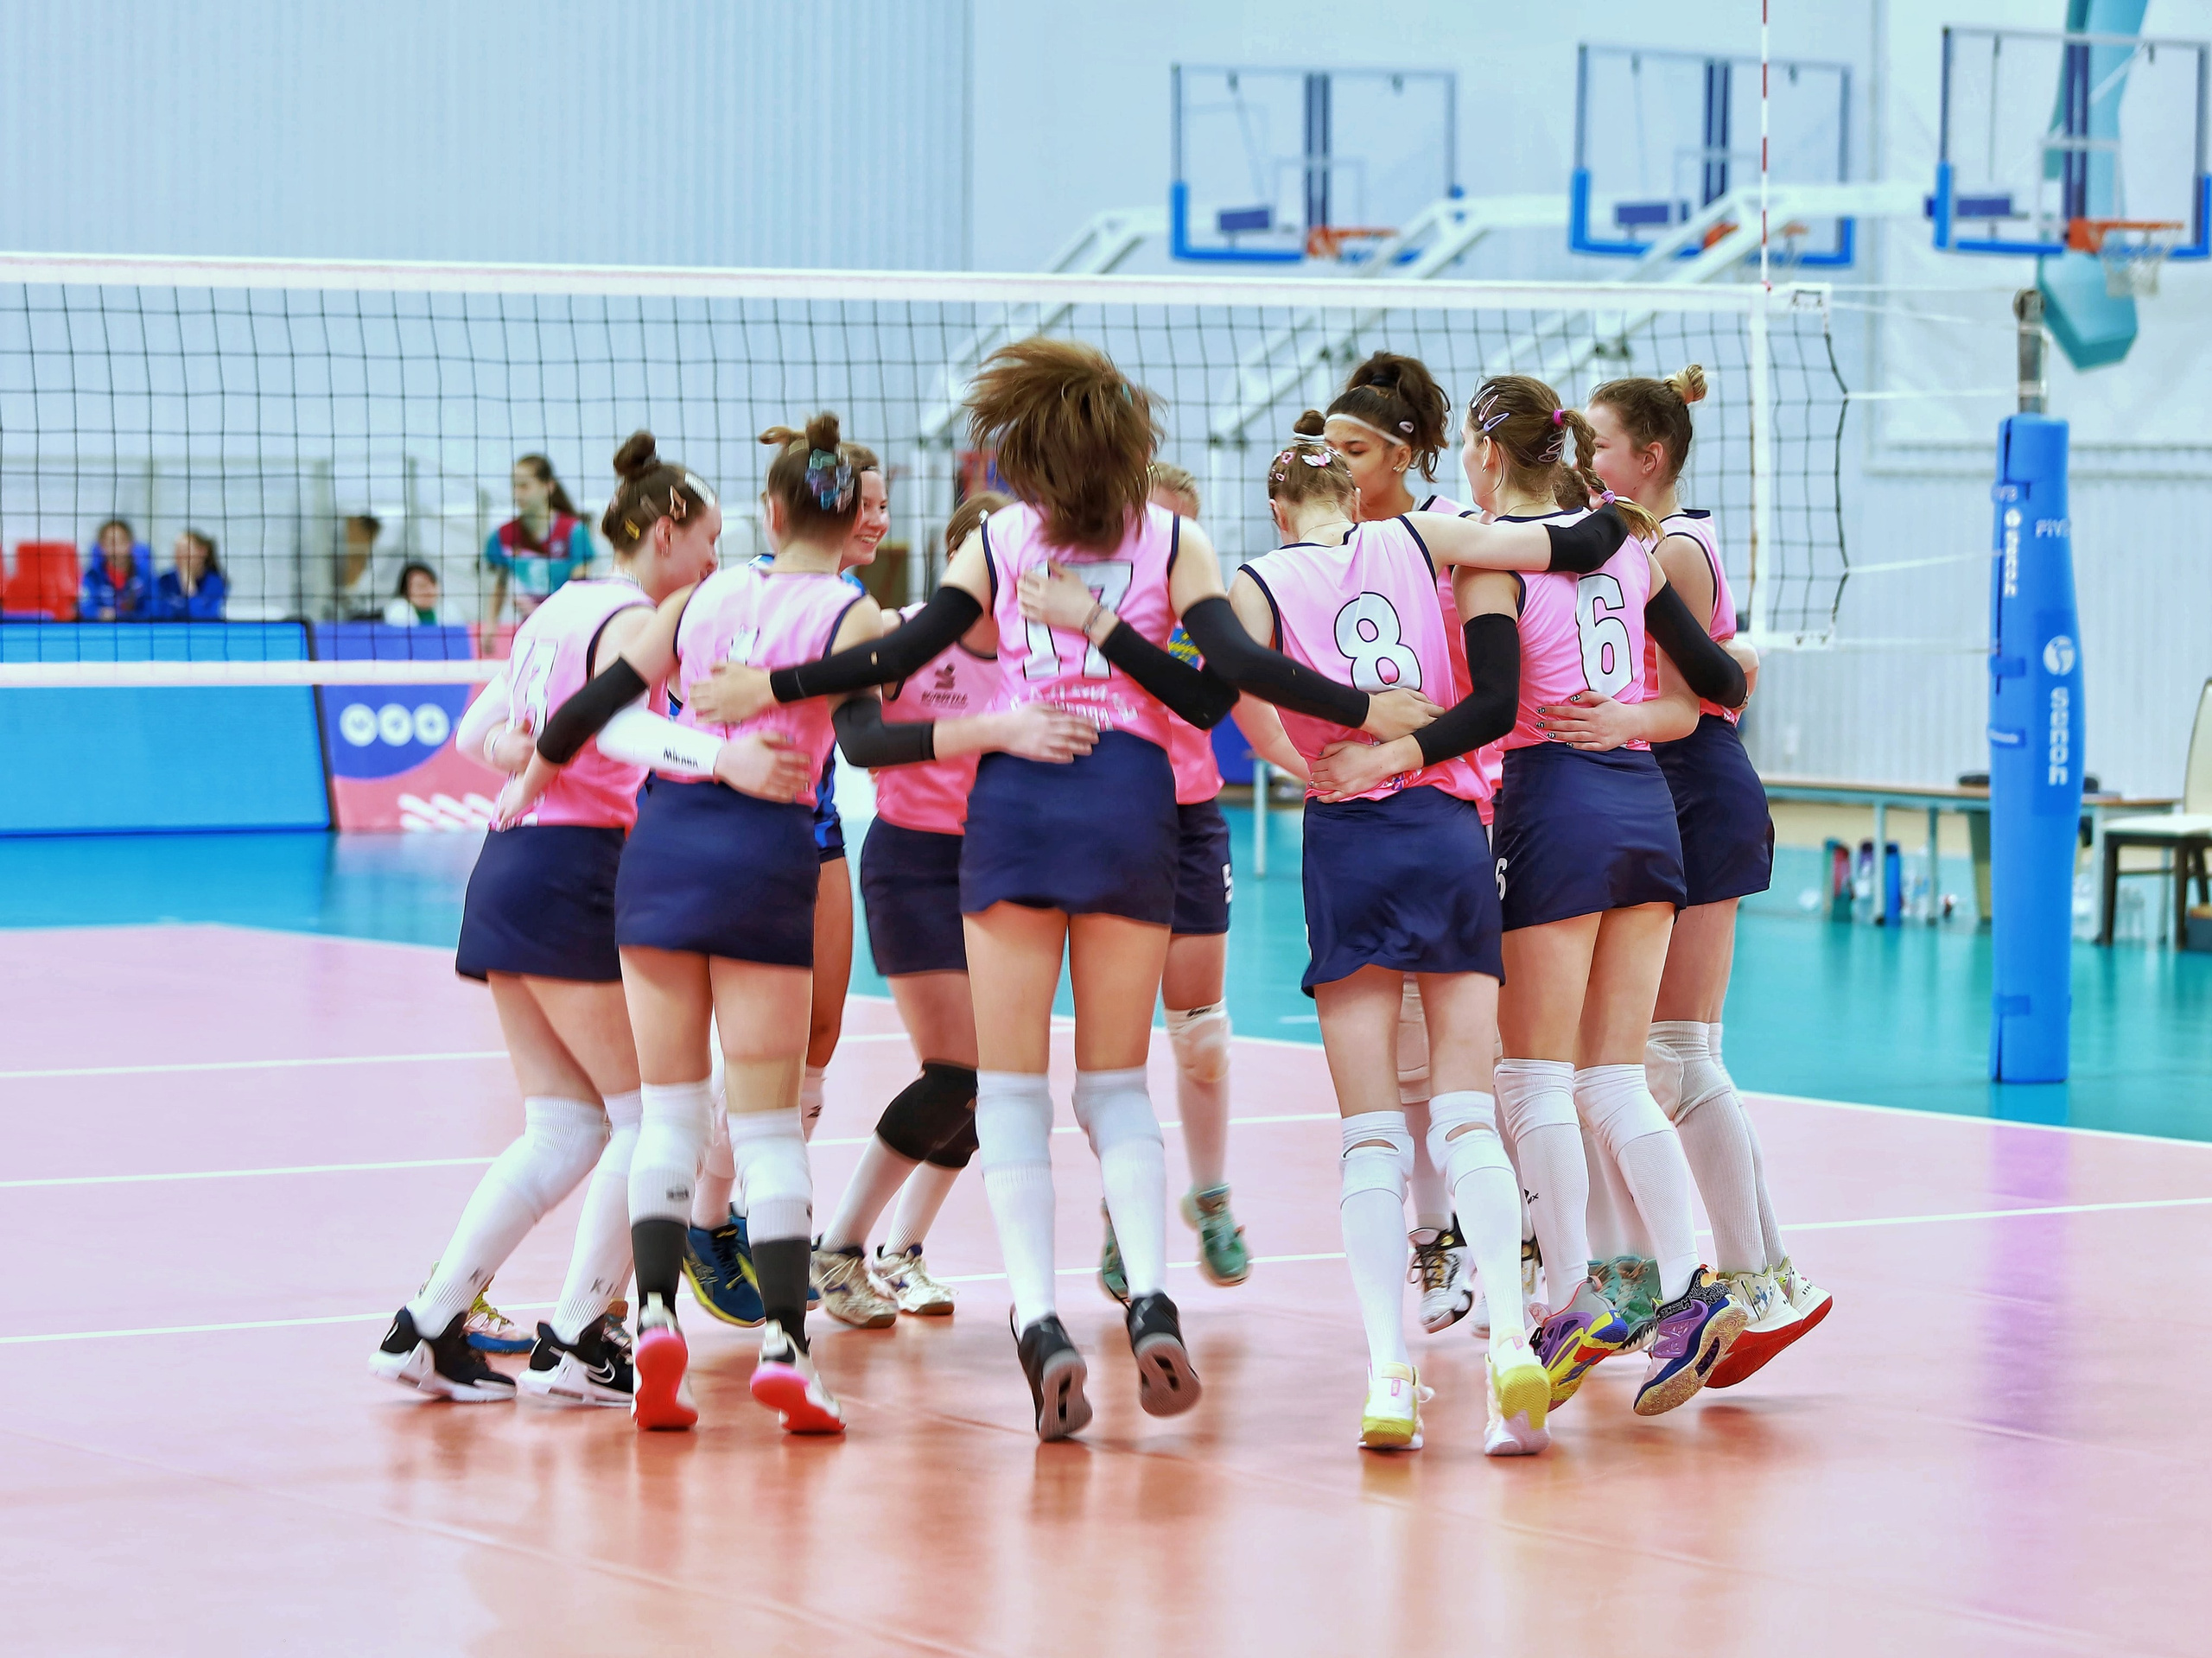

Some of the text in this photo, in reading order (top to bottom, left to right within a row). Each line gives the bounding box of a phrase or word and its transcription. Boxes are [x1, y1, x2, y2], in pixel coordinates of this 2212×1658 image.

[1023, 560, 1134, 680] 17
[1333, 591, 1422, 692] 8
[1575, 573, 1633, 698] 6
[1495, 857, 1508, 901] 6
